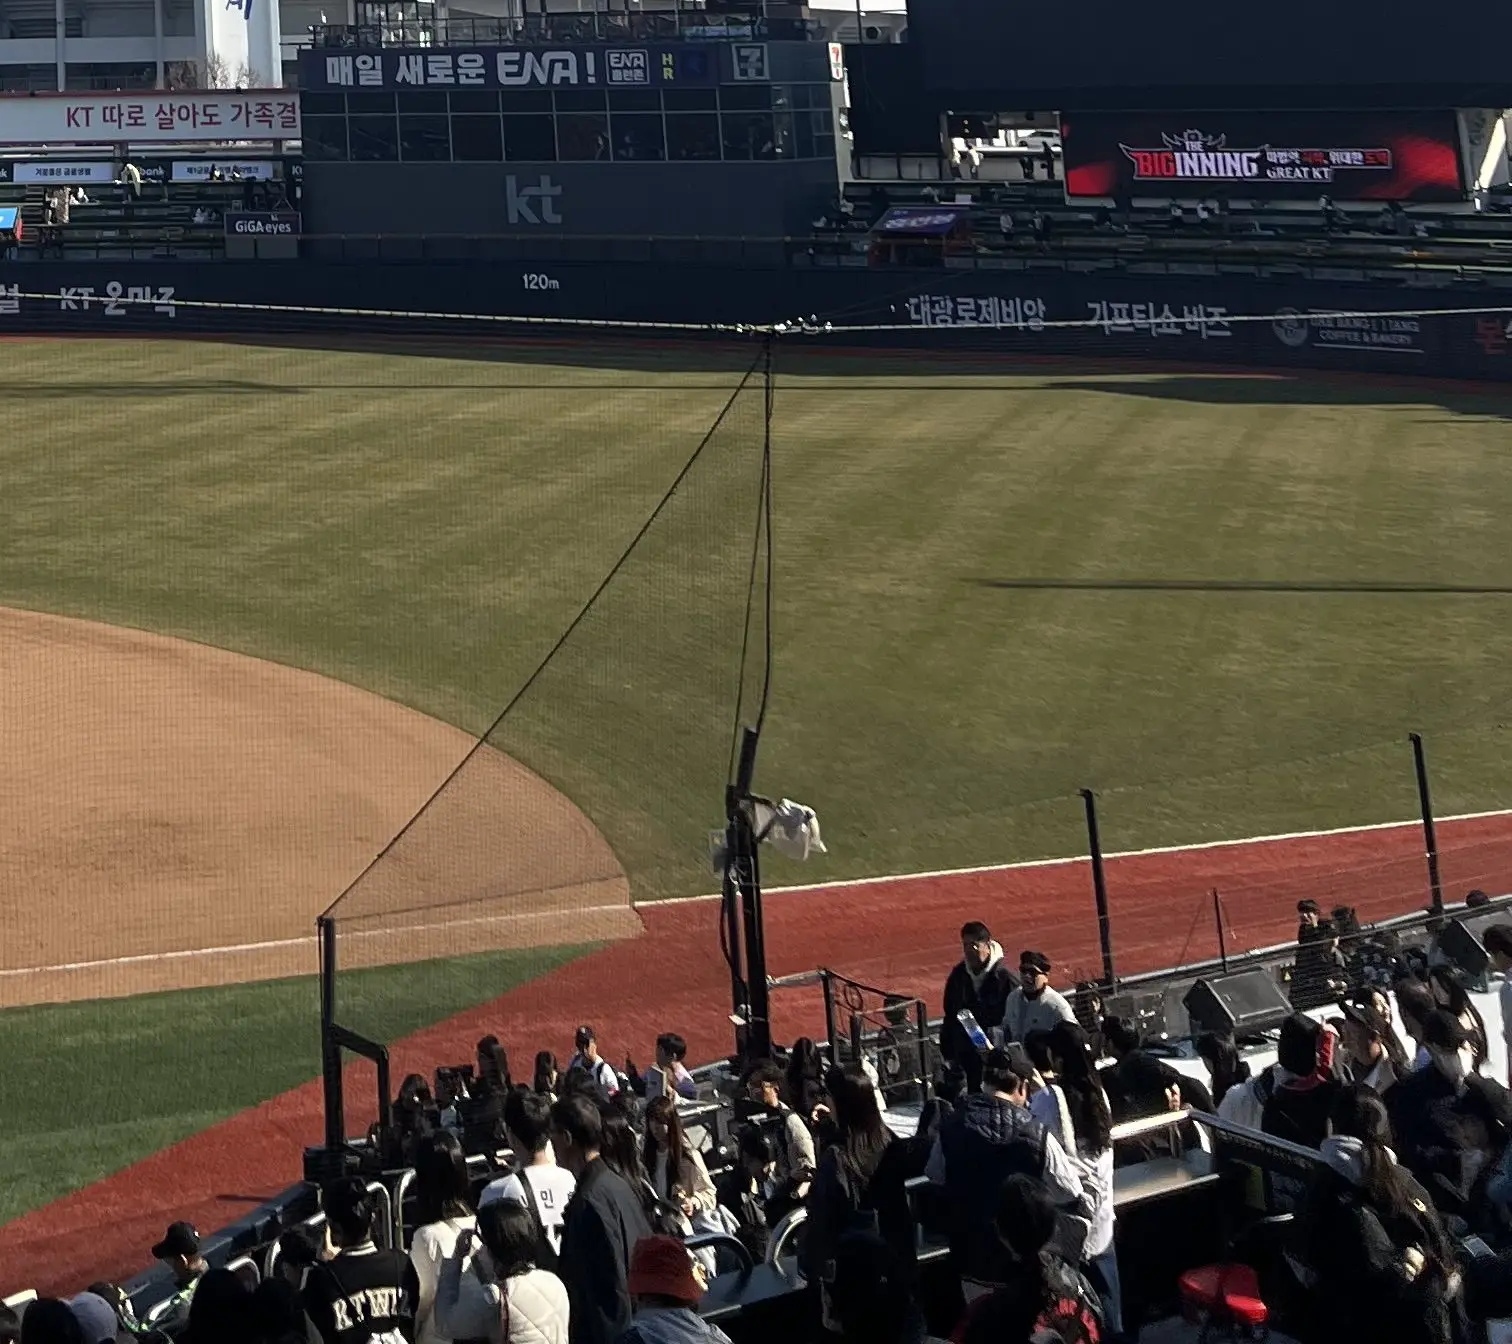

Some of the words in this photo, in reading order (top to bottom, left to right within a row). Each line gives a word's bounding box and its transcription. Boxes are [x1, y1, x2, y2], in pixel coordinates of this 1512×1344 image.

[326, 54, 383, 86] 매일
[395, 53, 486, 86] 새로운
[66, 106, 95, 129] KT
[102, 104, 147, 131] 따로
[154, 102, 223, 131] 살아도
[1185, 140, 1203, 152] THE
[1129, 151, 1260, 178] BIGINNING
[1266, 167, 1311, 180] GREAT
[1312, 167, 1332, 180] KT
[506, 174, 562, 224] kt
[265, 222, 291, 235] eyes
[522, 273, 560, 291] 120m
[59, 286, 95, 310] KT
[908, 294, 1046, 332] 대광로제비앙
